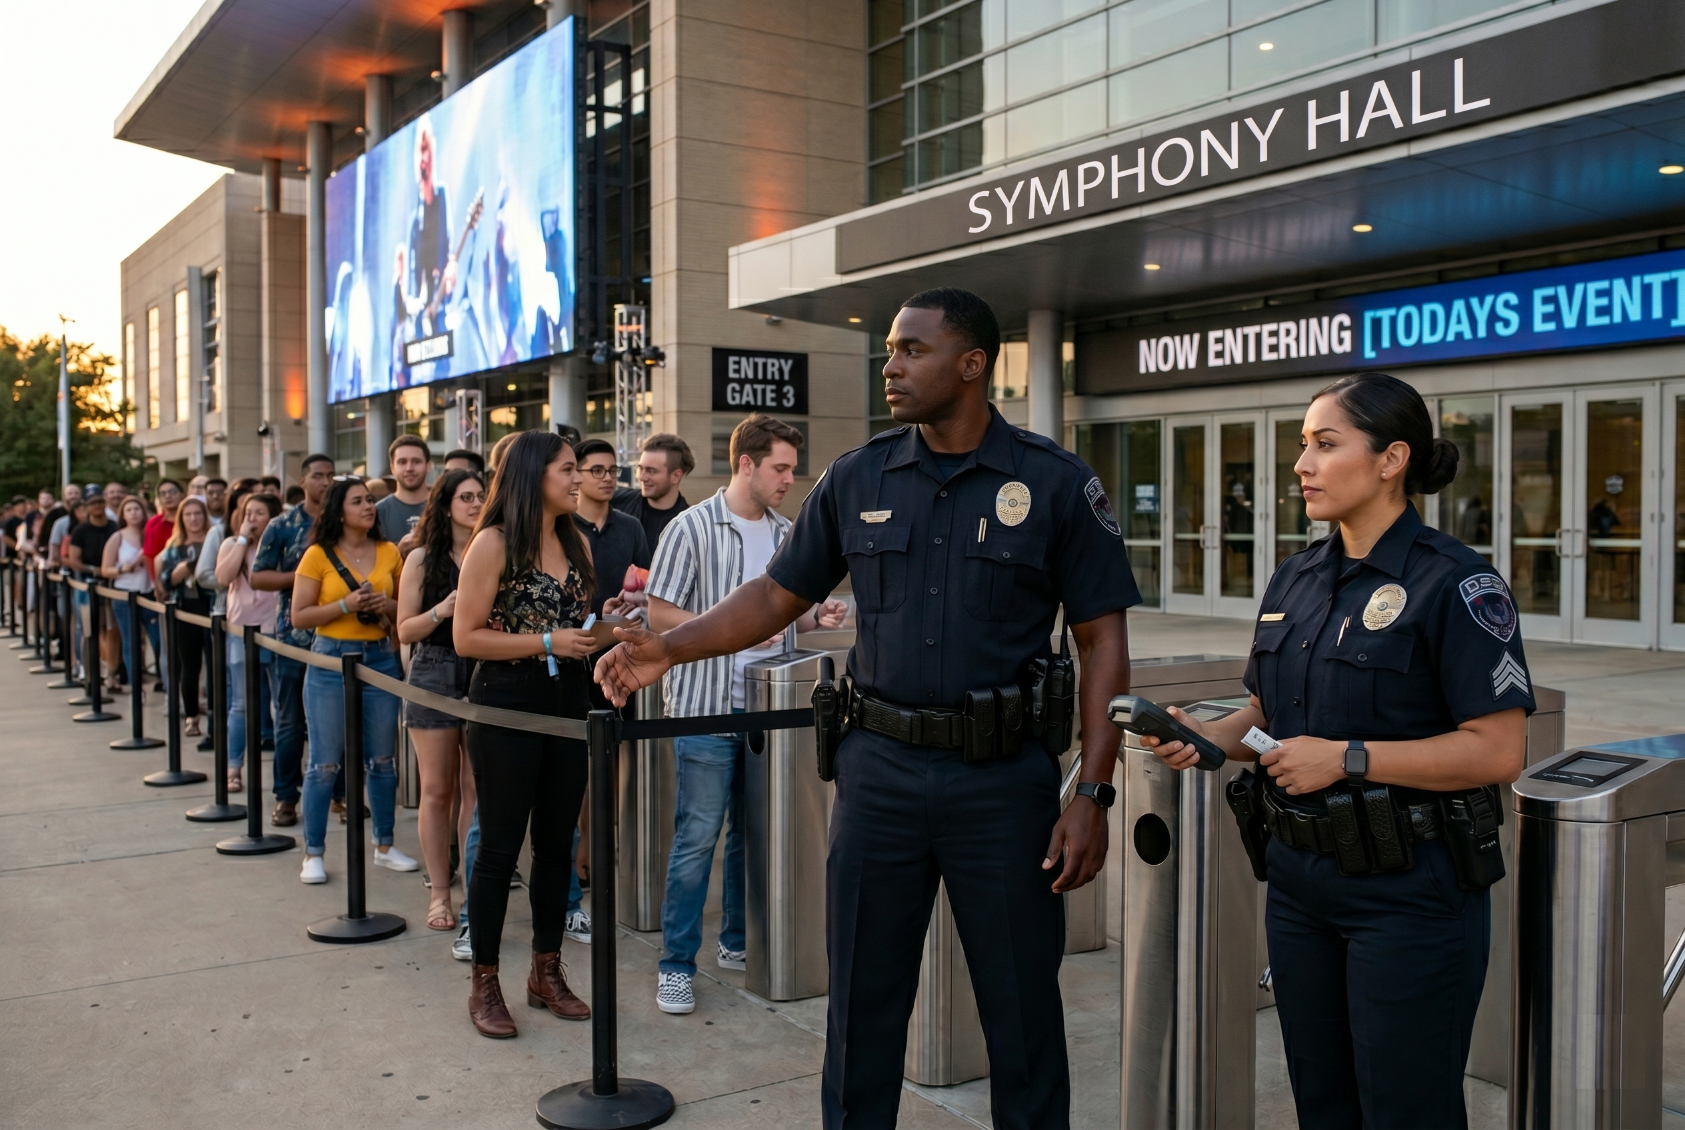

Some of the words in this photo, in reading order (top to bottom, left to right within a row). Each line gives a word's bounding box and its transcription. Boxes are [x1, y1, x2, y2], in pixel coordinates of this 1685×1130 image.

[968, 108, 1285, 234] SYMPHONY
[1307, 57, 1491, 151] HALL
[1138, 332, 1201, 375] NOW
[1207, 312, 1352, 368] ENTERING
[1363, 292, 1521, 360] [TODAYS
[1532, 268, 1685, 334] EVENT]
[726, 382, 778, 407] GATE
[782, 385, 796, 408] 3
[727, 355, 793, 381] ENTRY
